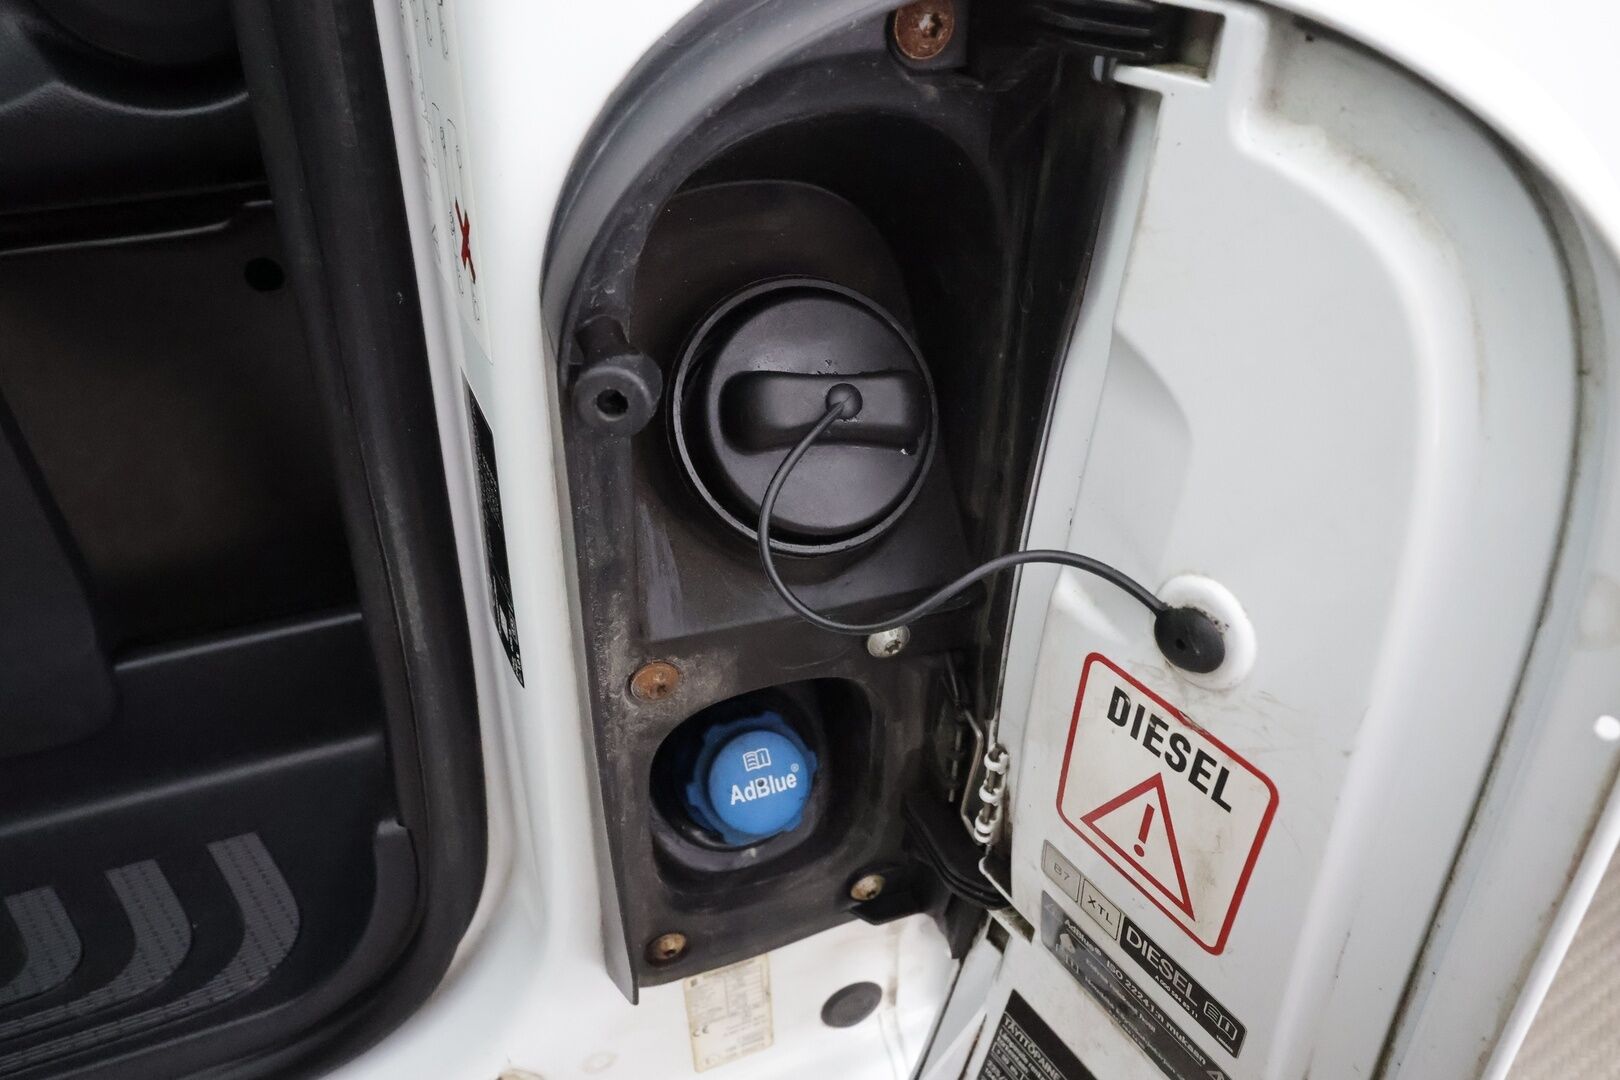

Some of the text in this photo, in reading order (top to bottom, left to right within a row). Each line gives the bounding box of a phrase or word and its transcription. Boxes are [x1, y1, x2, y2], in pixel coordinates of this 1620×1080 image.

[1106, 685, 1232, 813] DIESEL
[1053, 862, 1070, 881] B7
[1087, 894, 1113, 926] XTL
[1106, 959, 1123, 980] ISO
[1126, 925, 1198, 1007] DIESEL
